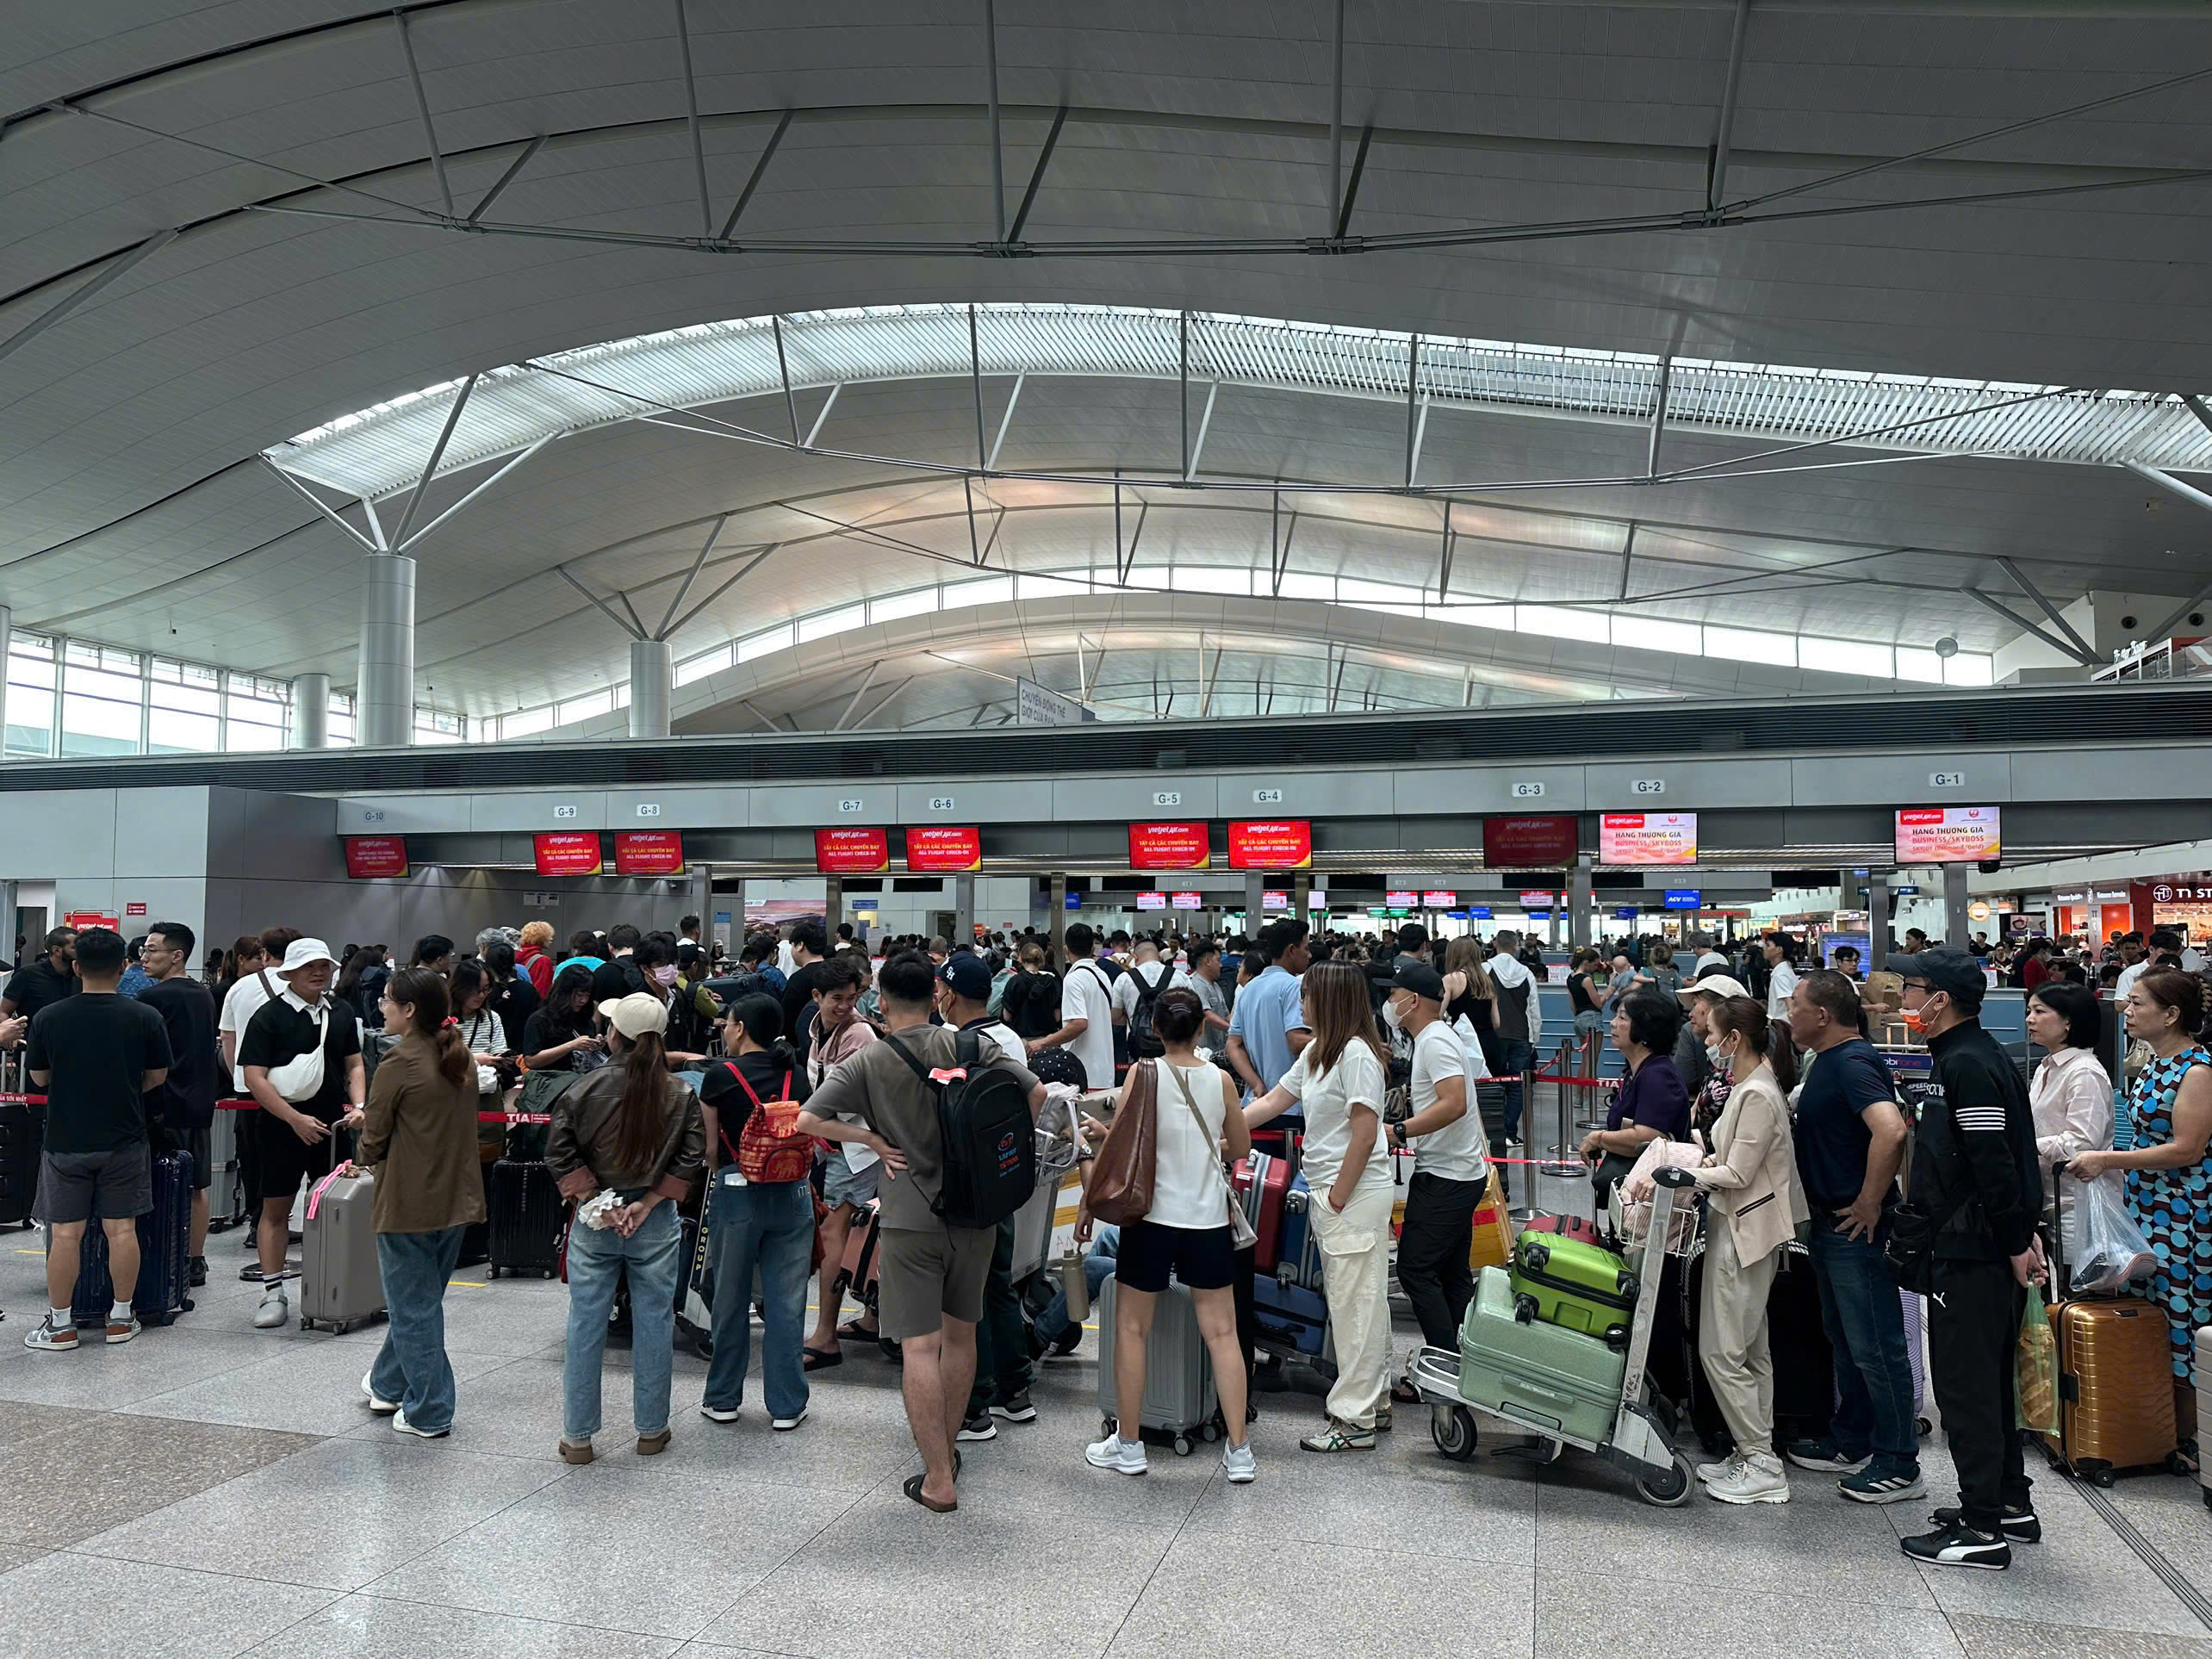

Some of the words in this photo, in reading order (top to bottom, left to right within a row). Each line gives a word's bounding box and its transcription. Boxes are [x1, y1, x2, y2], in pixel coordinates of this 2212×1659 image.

[1936, 774, 1959, 785] G-1
[1519, 785, 1540, 795] G-3
[1637, 781, 1661, 792] G-2
[1159, 794, 1177, 804] G-5
[1258, 792, 1278, 801] G-4
[842, 801, 860, 811] G-7
[934, 799, 951, 808] G-6
[558, 807, 574, 816] G-9
[641, 806, 657, 815] G-8
[365, 811, 383, 820] G-10
[1912, 835, 1984, 843] BUSINESS/SKYBOSS
[2196, 888, 2212, 898] ST
[1884, 1057, 1923, 1066] obifone
[1596, 1079, 1619, 1088] TIA
[506, 1114, 530, 1122] TIA
[695, 1227, 709, 1271] GROUP
